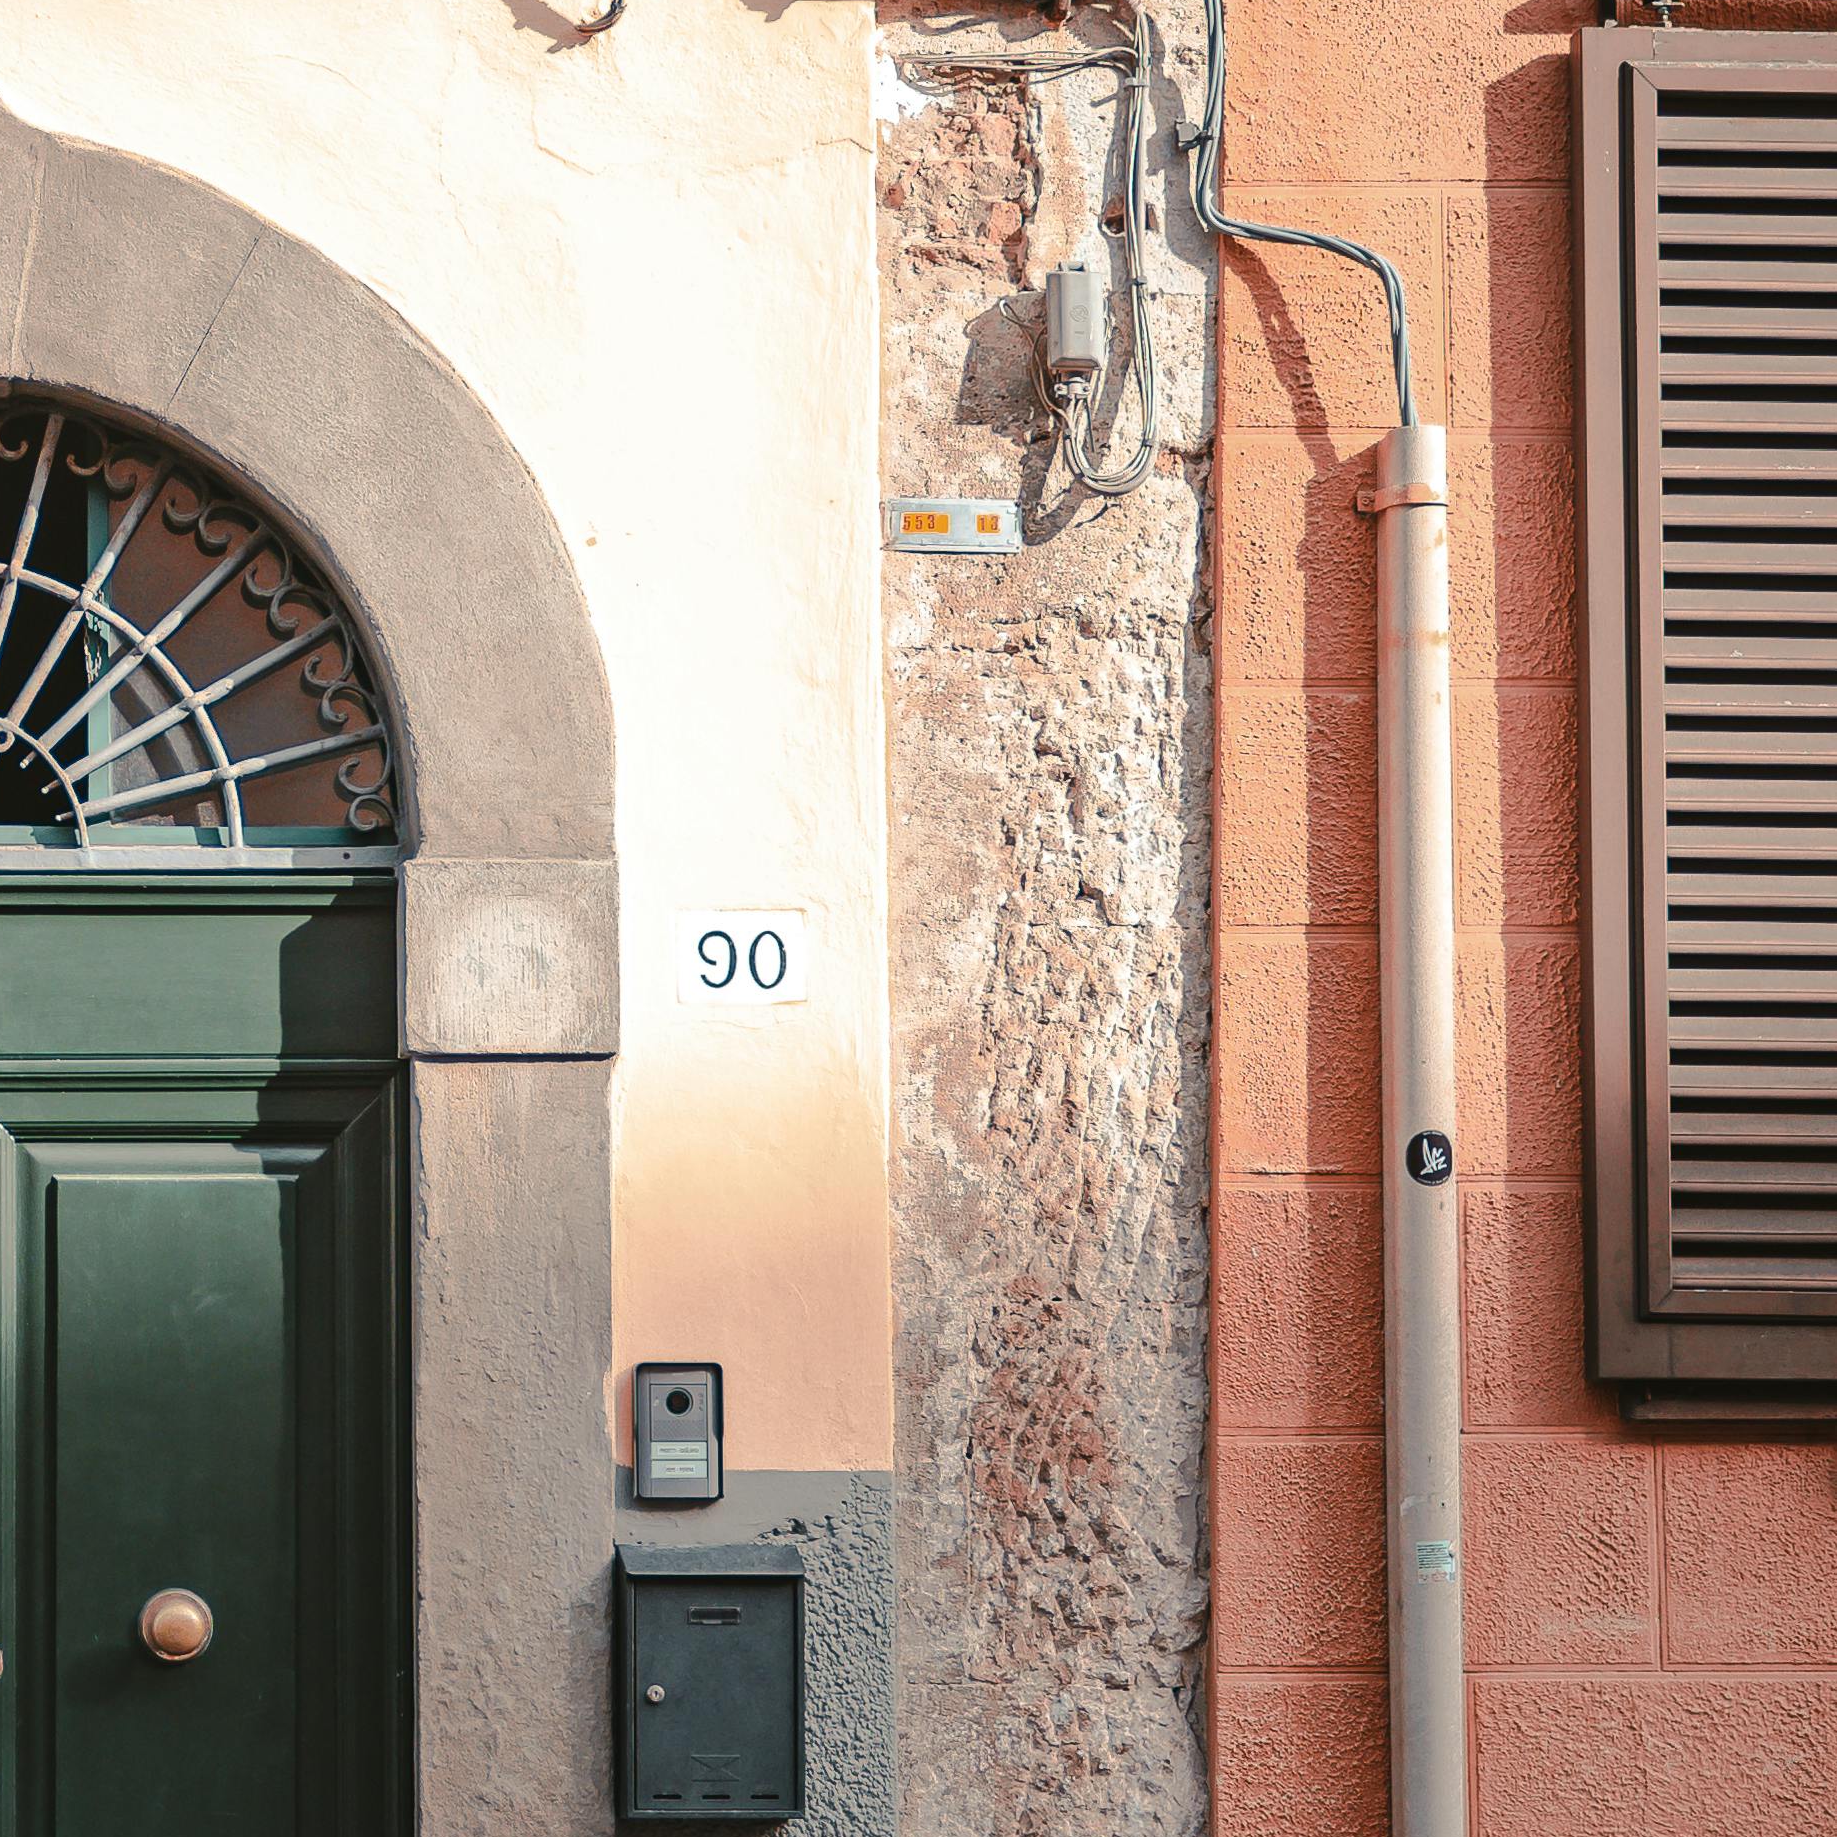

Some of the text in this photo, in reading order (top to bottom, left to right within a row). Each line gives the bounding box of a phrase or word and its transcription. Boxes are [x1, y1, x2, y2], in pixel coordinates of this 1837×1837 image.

[901, 514, 1000, 532] 553 13
[697, 930, 787, 990] 90
